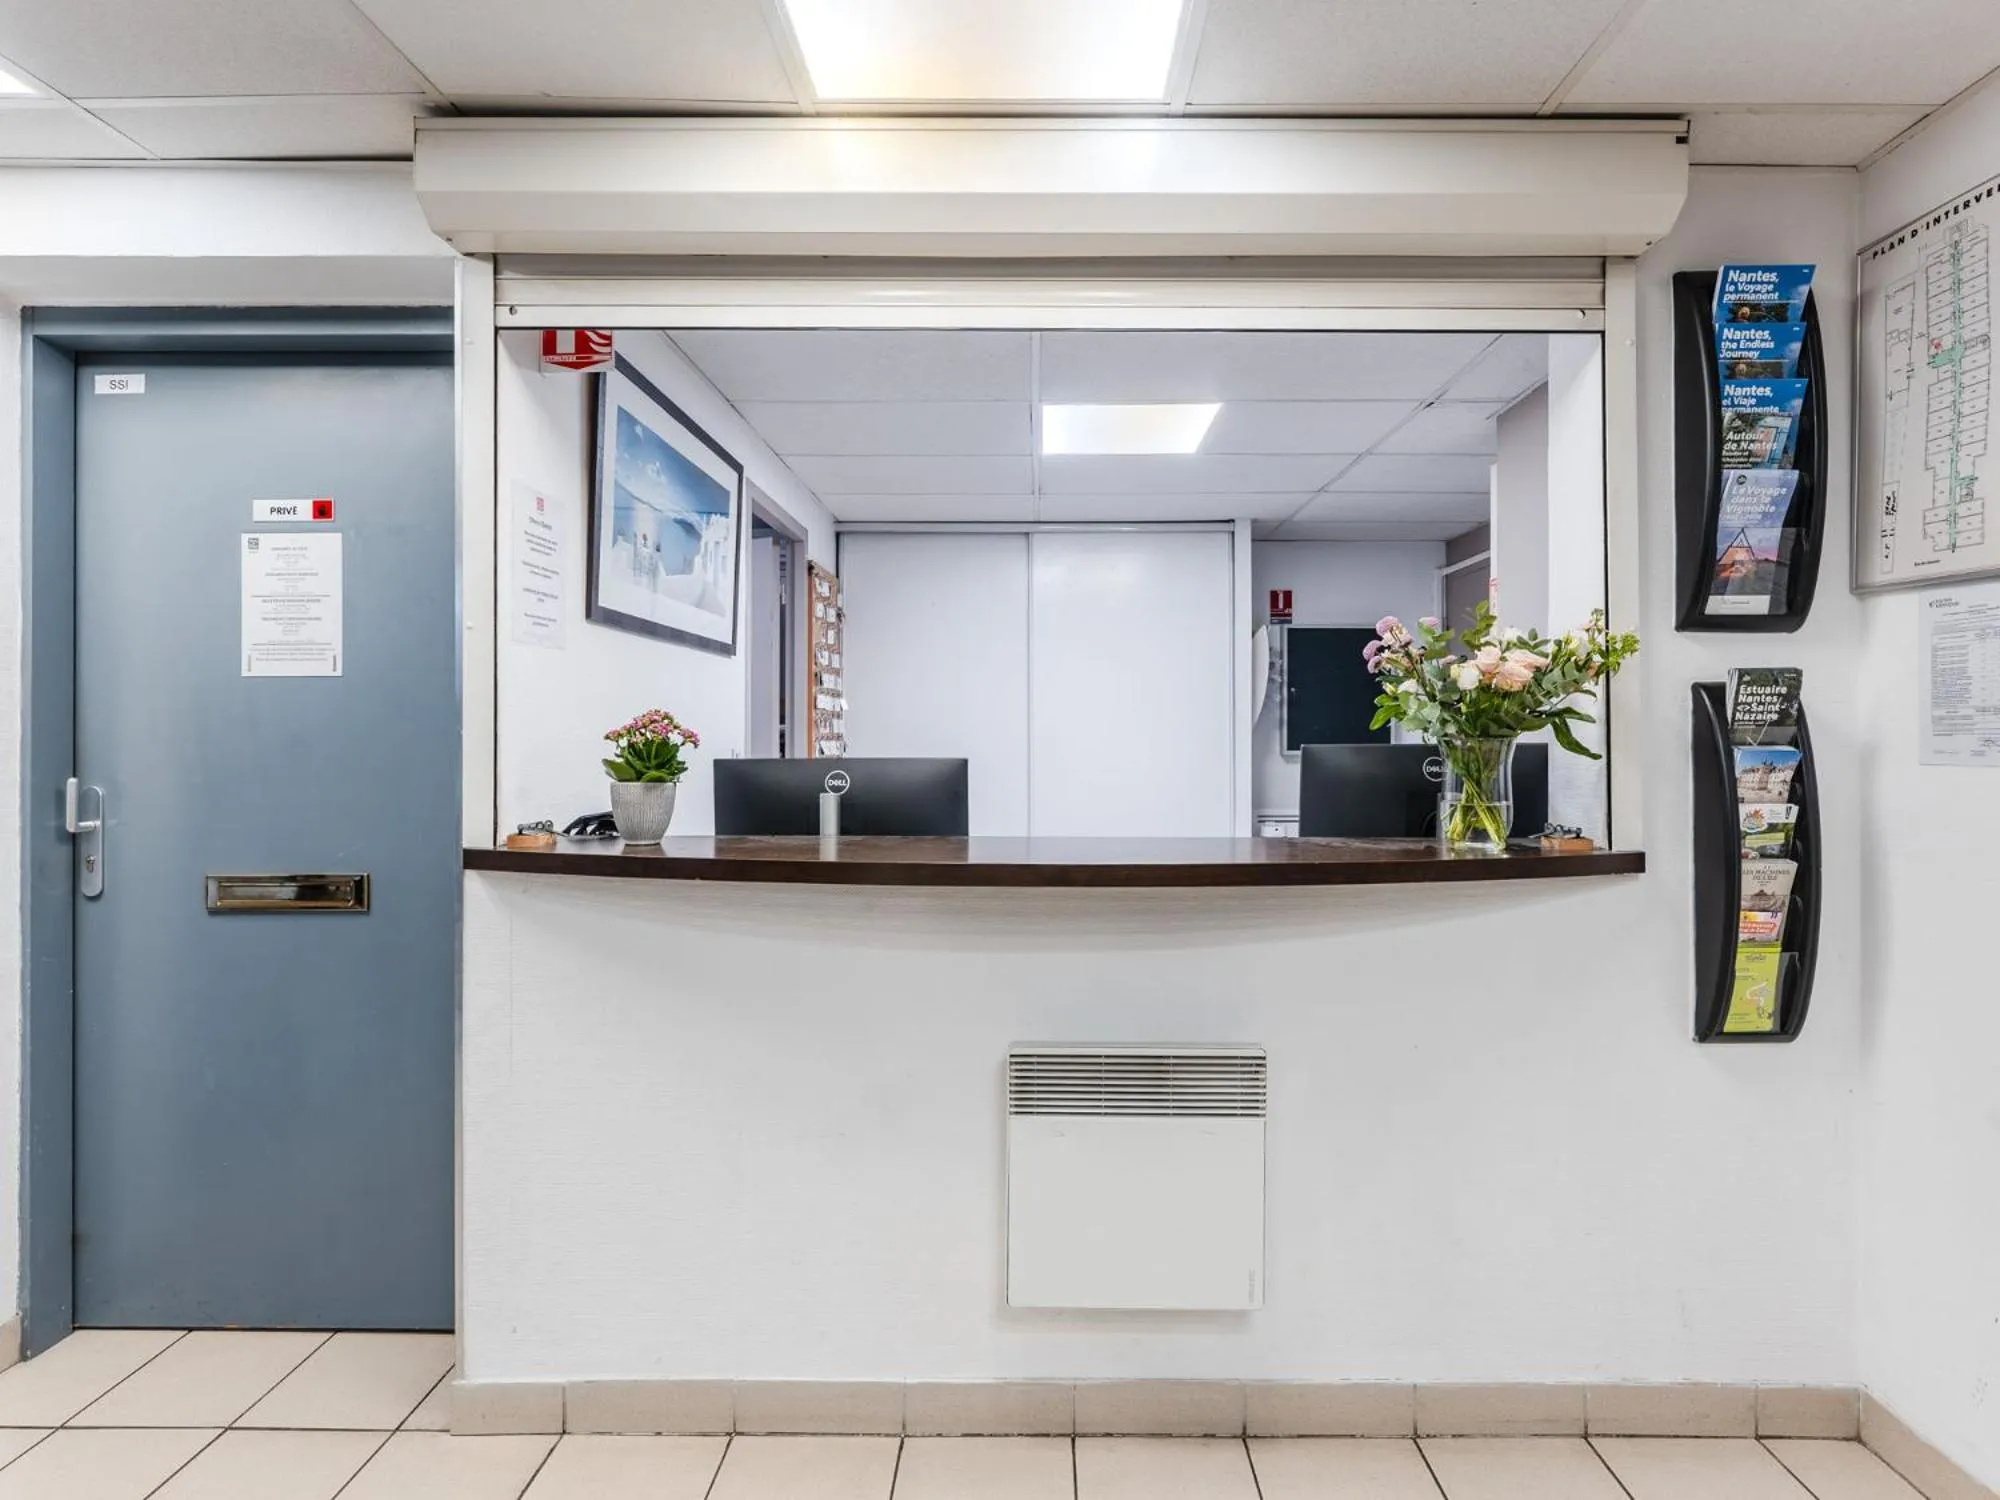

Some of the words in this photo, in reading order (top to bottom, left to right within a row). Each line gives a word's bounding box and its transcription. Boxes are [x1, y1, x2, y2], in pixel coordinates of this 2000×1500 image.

[1873, 236, 1906, 260] PLAN
[1911, 183, 2000, 239] D'INTERVE
[1728, 270, 1779, 284] Nantes,
[1725, 282, 1736, 292] le
[1738, 282, 1774, 294] Voyage
[1723, 292, 1780, 304] permanent
[1722, 327, 1772, 341] Nantes,
[1721, 340, 1738, 349] the
[1739, 339, 1775, 349] Endless
[1719, 348, 1760, 359] Journey
[109, 379, 129, 391] SSI
[1723, 384, 1774, 399] Nantes,
[1734, 396, 1757, 408] Viaje
[1726, 431, 1764, 441] Autour
[1723, 440, 1738, 450] de
[1740, 684, 1788, 695] Estuaire
[1738, 694, 1778, 703] Nantes
[1735, 711, 1779, 721] Nazaire
